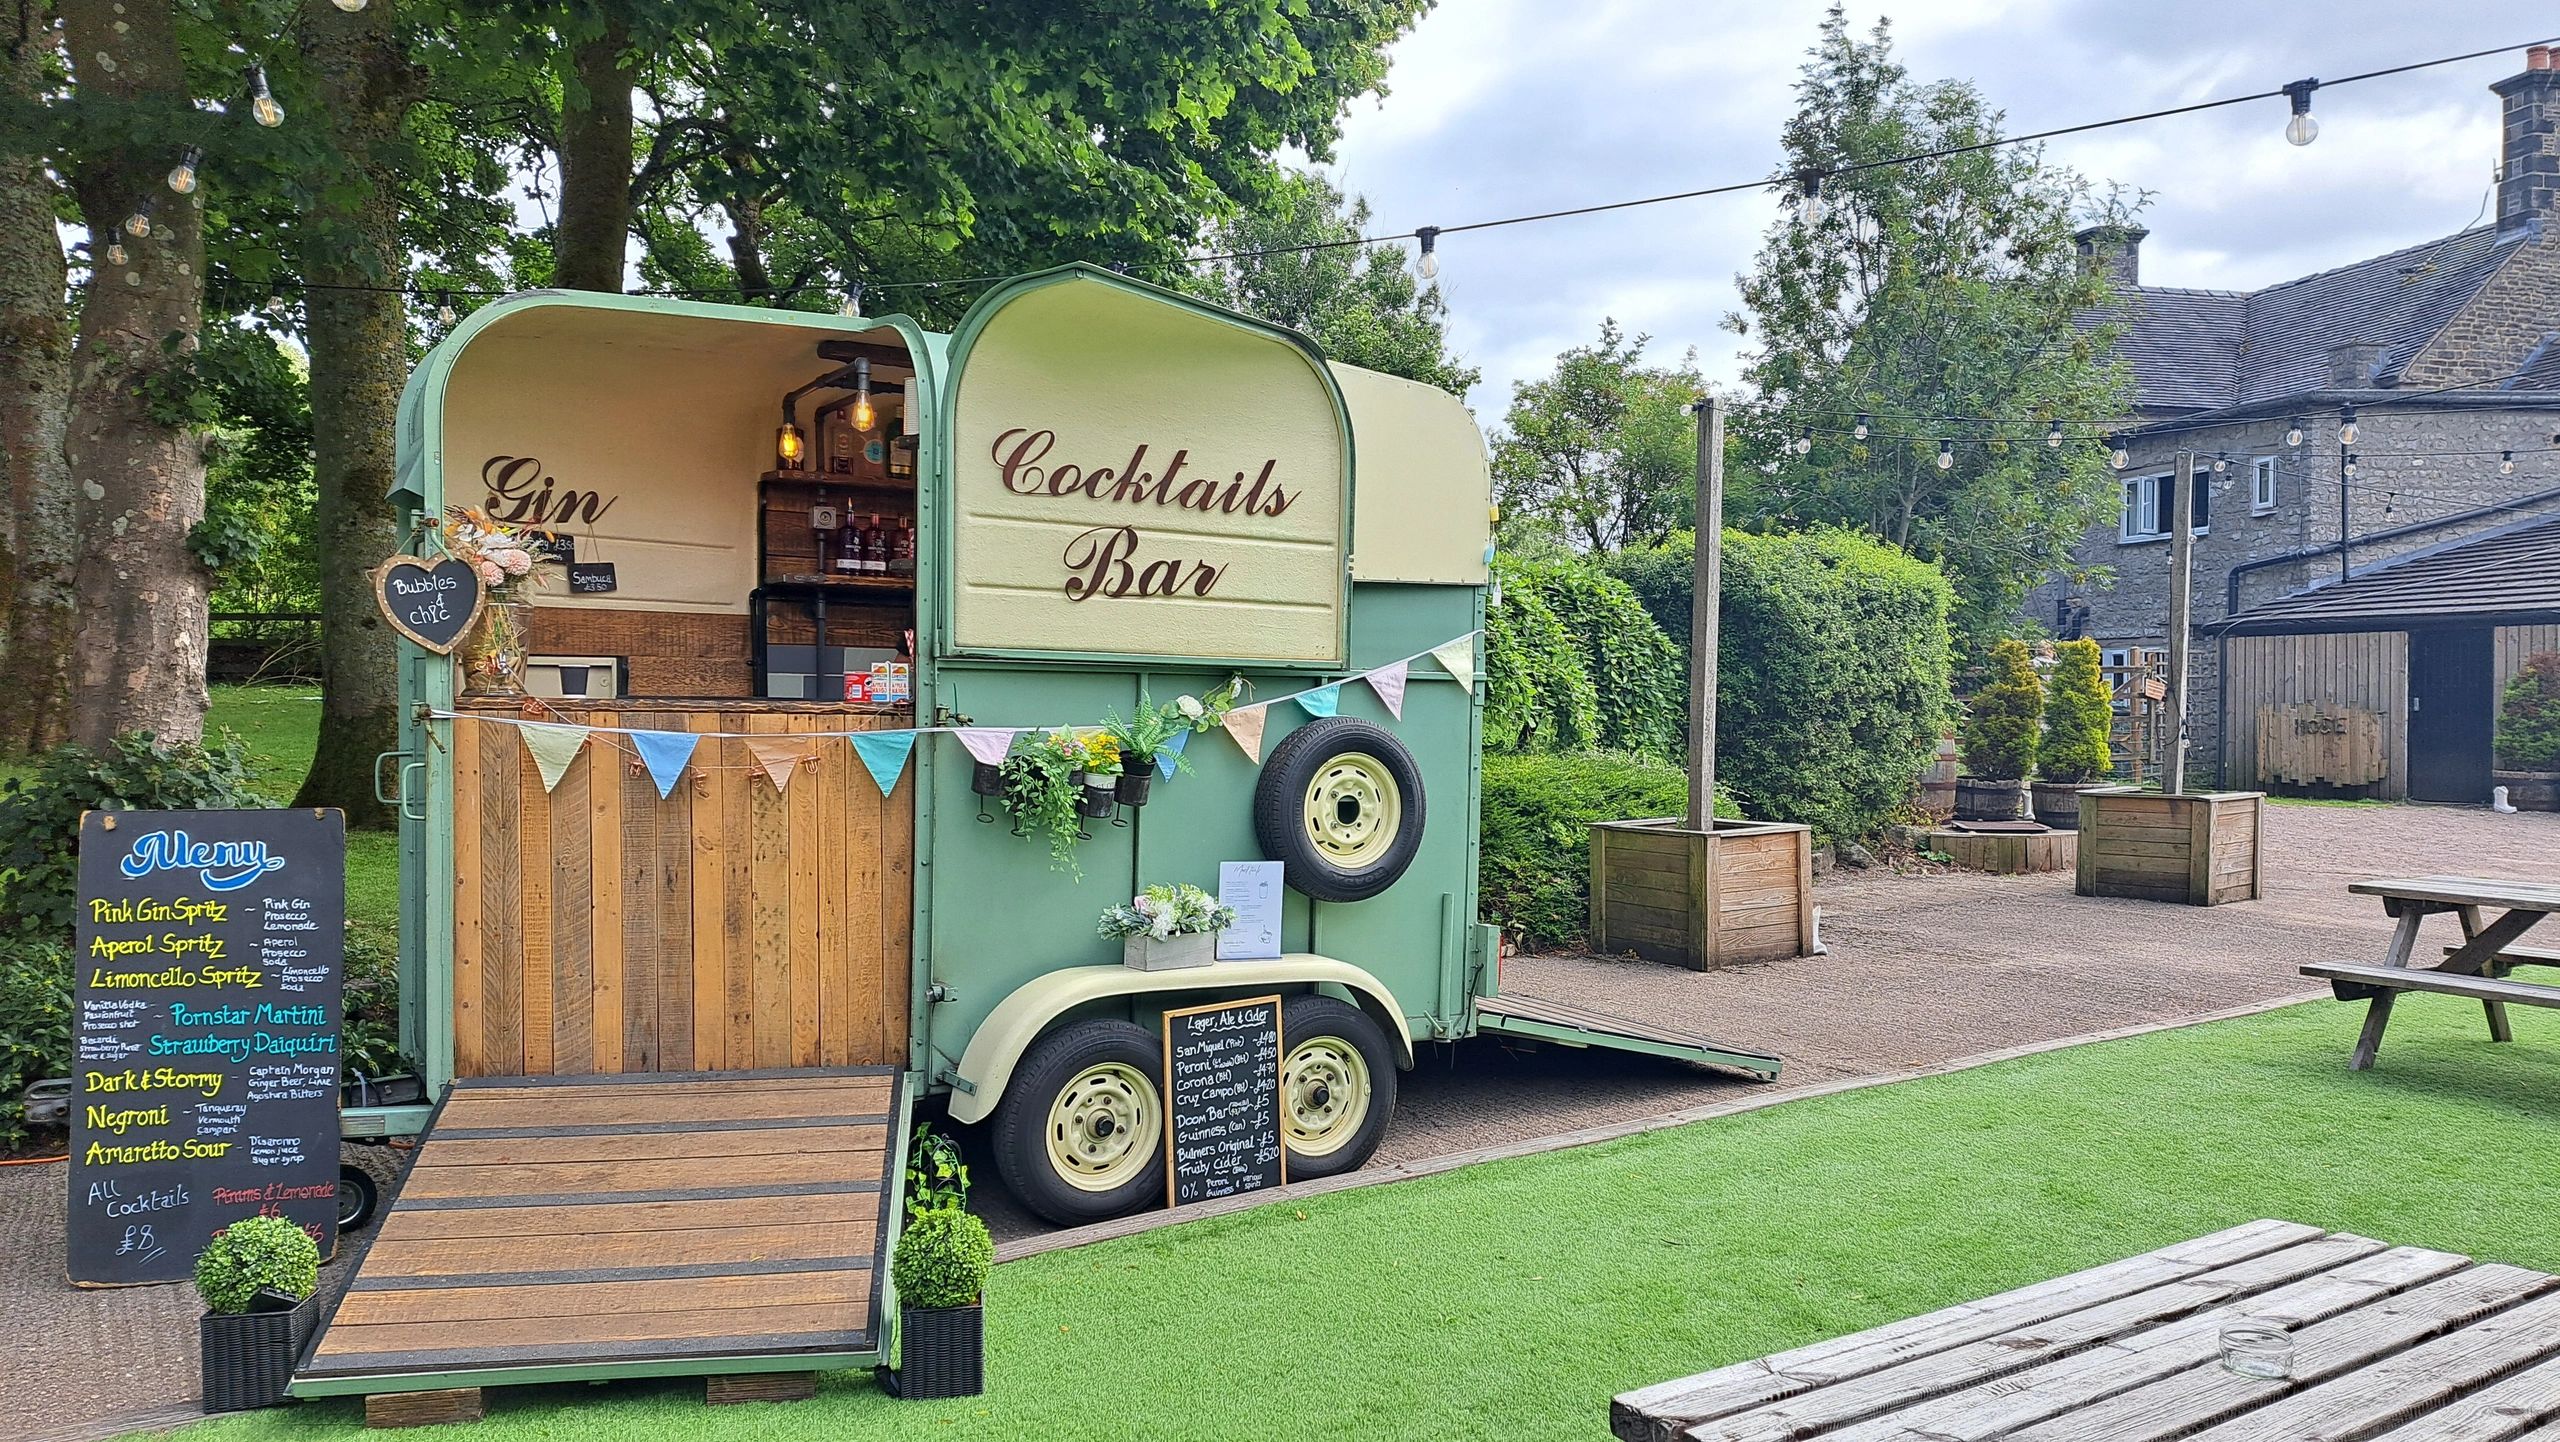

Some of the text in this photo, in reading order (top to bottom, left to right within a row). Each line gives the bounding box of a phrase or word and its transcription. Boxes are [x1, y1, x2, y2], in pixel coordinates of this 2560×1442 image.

[991, 428, 1302, 517] Cocktails
[482, 456, 619, 525] Gin
[1063, 524, 1229, 602] Bar
[393, 574, 457, 595] Bubbles
[572, 572, 613, 584] Sambuca
[121, 831, 285, 891] Menu
[89, 897, 228, 925] Pink Gin Spritz
[263, 898, 310, 910] Pink Gin
[264, 911, 307, 920] Prosecco
[264, 920, 319, 930] Lemonade
[90, 932, 227, 961] Aperol Spritz
[263, 936, 297, 947] Aperol
[261, 948, 307, 957] Prosecco
[90, 965, 263, 989] Limoncello Spritz
[282, 965, 330, 975] Limoncello
[282, 975, 324, 983] Prosecco
[83, 1000, 148, 1010] Vanilla Vodka
[169, 1003, 327, 1027] Pornstar Martini
[1187, 1016, 1217, 1032] Lager,
[1220, 1010, 1235, 1025] Ale
[1245, 1008, 1269, 1022] Cider
[82, 1021, 117, 1030] Prosecco
[148, 1031, 336, 1063] Strawberry Daiquiri
[1176, 1046, 1196, 1058] San
[1197, 1039, 1224, 1058] Miguel
[249, 1063, 334, 1078] Captain Morgan
[1176, 1059, 1211, 1076] Peroni
[85, 1069, 139, 1092] Dark
[150, 1068, 223, 1097] Stormy
[248, 1078, 280, 1092] Ginger
[281, 1077, 306, 1087] Beer,
[1176, 1075, 1214, 1091] Corona
[289, 1088, 324, 1099] Bitters
[1177, 1095, 1200, 1107] Cruz
[1202, 1088, 1234, 1100] Campo
[194, 1103, 247, 1116] Tanqueray
[1176, 1114, 1206, 1128] Doom
[1206, 1106, 1228, 1121] Bar
[86, 1105, 170, 1134] Negroni
[198, 1115, 241, 1124] Vermouth
[196, 1125, 238, 1136] Campari
[1178, 1125, 1227, 1143] Guinness
[248, 1136, 300, 1146] Disaronno
[1177, 1145, 1216, 1163] Bulmers
[1218, 1135, 1255, 1156] Original
[85, 1139, 233, 1166] Amaretto Sour
[250, 1147, 275, 1155] Lemon
[1178, 1160, 1210, 1178] Fruity
[1213, 1154, 1242, 1170] Cider
[1181, 1181, 1198, 1198] 0%
[1206, 1176, 1229, 1188] Peroni
[1206, 1185, 1234, 1197] Guinness
[87, 1180, 121, 1205] All
[106, 1184, 189, 1218] Cocktails
[212, 1187, 261, 1206] Pimms
[276, 1181, 335, 1200] Lemonade
[115, 1224, 155, 1256] £8
